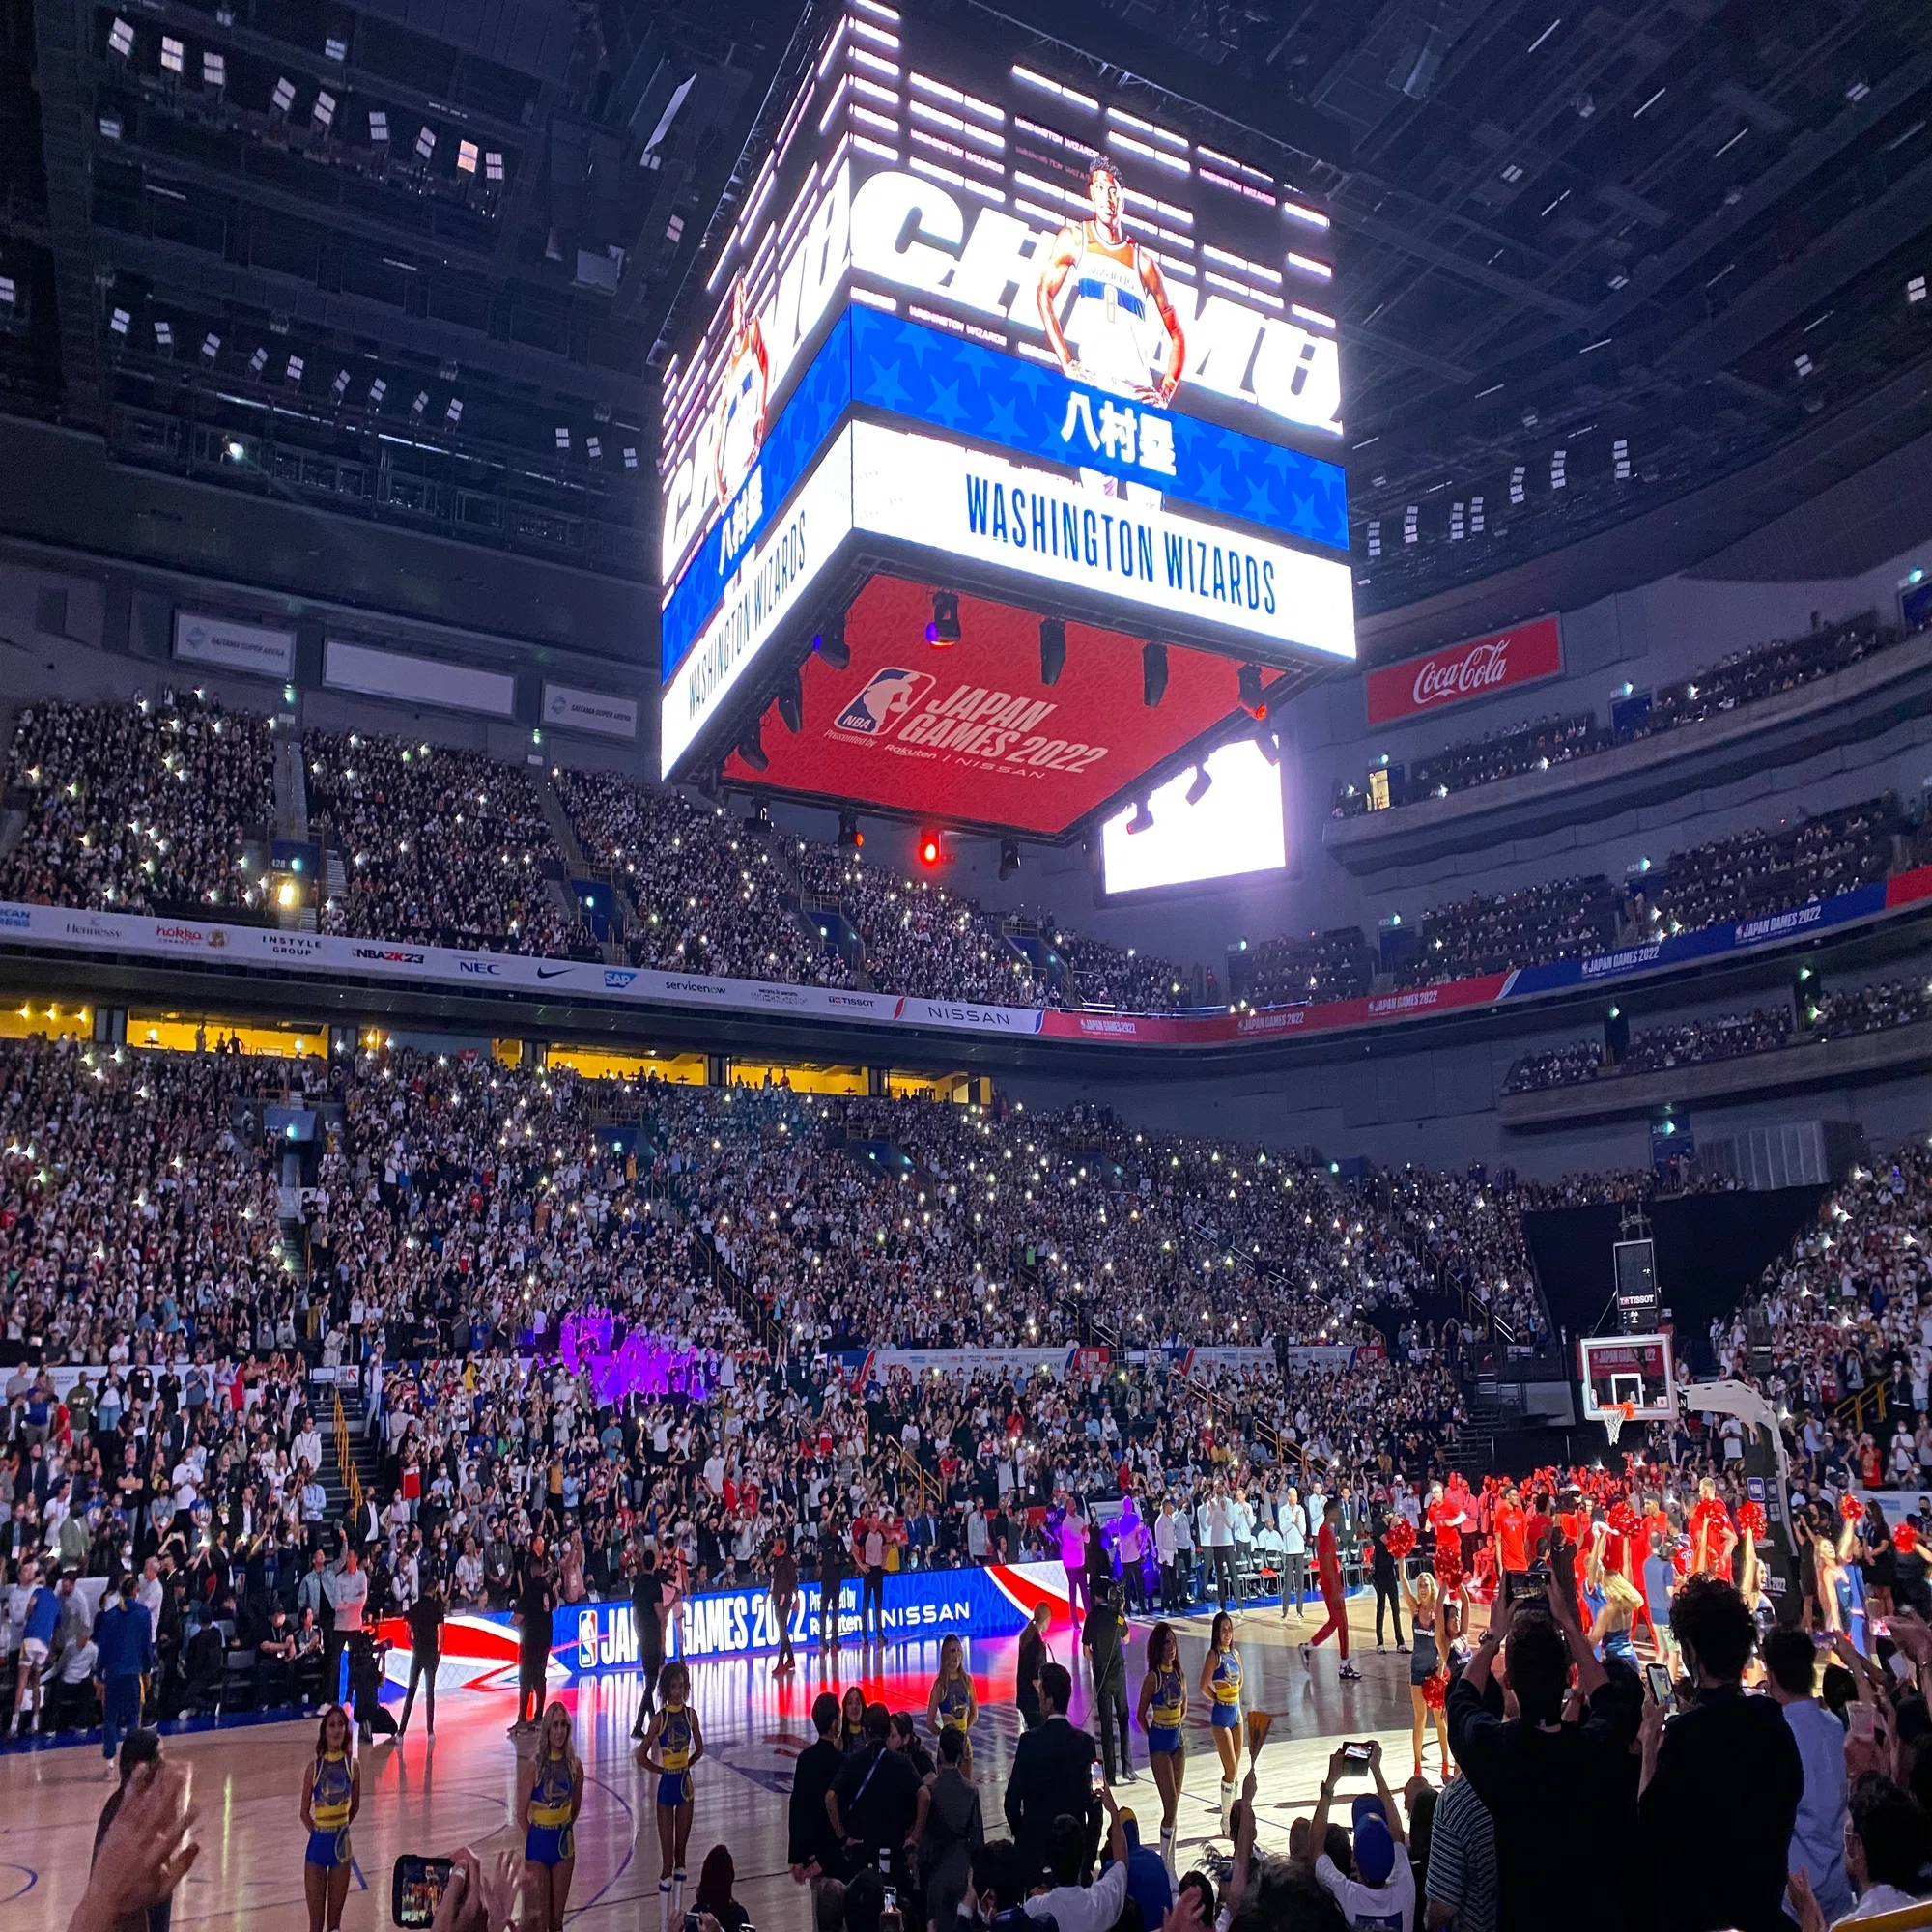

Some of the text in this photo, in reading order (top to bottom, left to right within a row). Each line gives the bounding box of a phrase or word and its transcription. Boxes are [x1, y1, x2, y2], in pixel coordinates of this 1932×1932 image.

[966, 474, 1275, 614] WASHINGTON WIZARDS
[689, 510, 806, 721] WASHINGTON WIZARDS
[241, 642, 263, 653] SUPER
[262, 646, 284, 657] ARENA
[1413, 639, 1511, 704] Coca-Cola
[571, 704, 631, 722] SAITAMA SUPER ARENA
[925, 685, 1058, 732] JAPAN
[843, 715, 870, 729] NBA
[824, 729, 877, 748] Presented by
[897, 714, 1108, 773] GAMES 2022
[884, 744, 1045, 779] Rakuten NISSAN
[66, 923, 121, 939] Hennessy
[1743, 920, 1770, 938] JAPAN
[1770, 912, 1797, 931] GAMES
[1798, 905, 1821, 924] 2022
[263, 935, 322, 949] INSTYLE
[272, 946, 312, 956] GROUP
[355, 948, 424, 964] NBA2K23
[1588, 956, 1612, 973] JAPAN
[1613, 951, 1638, 968] GAMES
[1638, 946, 1659, 961] 2022
[460, 961, 500, 975] NEC
[605, 972, 630, 986] SAP
[666, 980, 726, 995] servicenow
[840, 997, 874, 1008] TISSOT
[1375, 997, 1397, 1011] JAPAN
[1397, 993, 1418, 1009] GAMES
[1419, 990, 1438, 1004] 2022
[928, 1006, 1010, 1025] NISSAN
[1243, 1011, 1304, 1031] JAPAN GAMES 2022
[1630, 1294, 1654, 1304] TISSOT
[881, 1602, 970, 1629] NISSAN
[682, 1596, 748, 1655] GAMES
